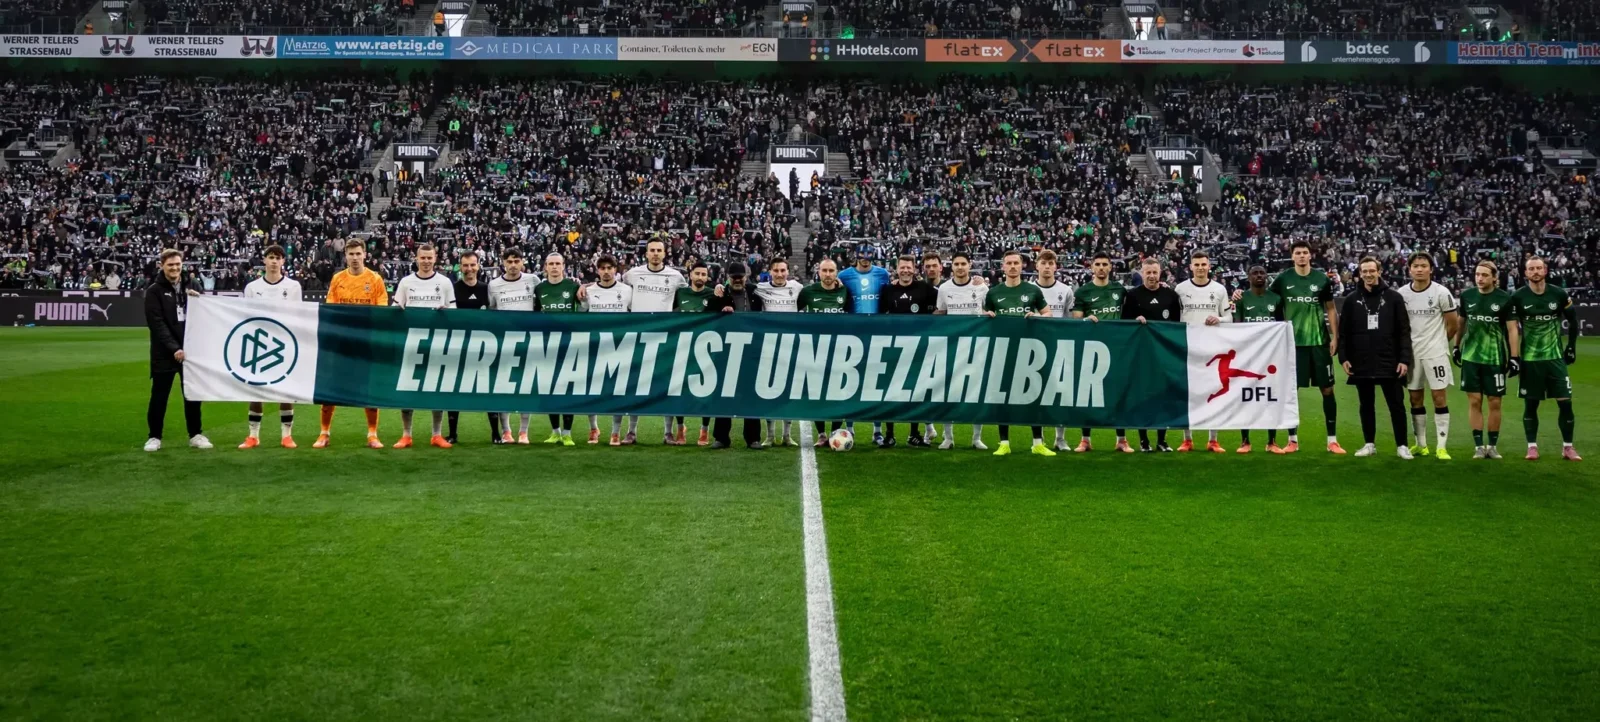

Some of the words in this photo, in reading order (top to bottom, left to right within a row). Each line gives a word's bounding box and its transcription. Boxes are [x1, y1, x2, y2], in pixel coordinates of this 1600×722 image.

[335, 40, 444, 52] www.raetzig.de
[487, 44, 563, 54] MEDICAL
[573, 44, 614, 54] PARK
[620, 44, 660, 53] Container,
[662, 45, 696, 53] Toiletten
[752, 43, 775, 52] EGN
[836, 44, 918, 56] H-Hotels.com
[1346, 42, 1389, 54] batec
[1458, 43, 1526, 56] Heinrich
[9, 47, 72, 56] STRASSENBAU
[154, 48, 217, 56] STRASSENBAU
[398, 146, 428, 156] PUMA
[776, 148, 806, 158] PUMA
[1156, 150, 1186, 160] PUMA
[34, 302, 88, 320] PUMA
[1092, 306, 1120, 314] T-ROC
[396, 328, 668, 396] EHRENAMT
[667, 331, 753, 398] IST
[755, 333, 1111, 407] UNBEZAHLBAR
[1433, 366, 1446, 378] 18
[1242, 387, 1278, 401] DFL
